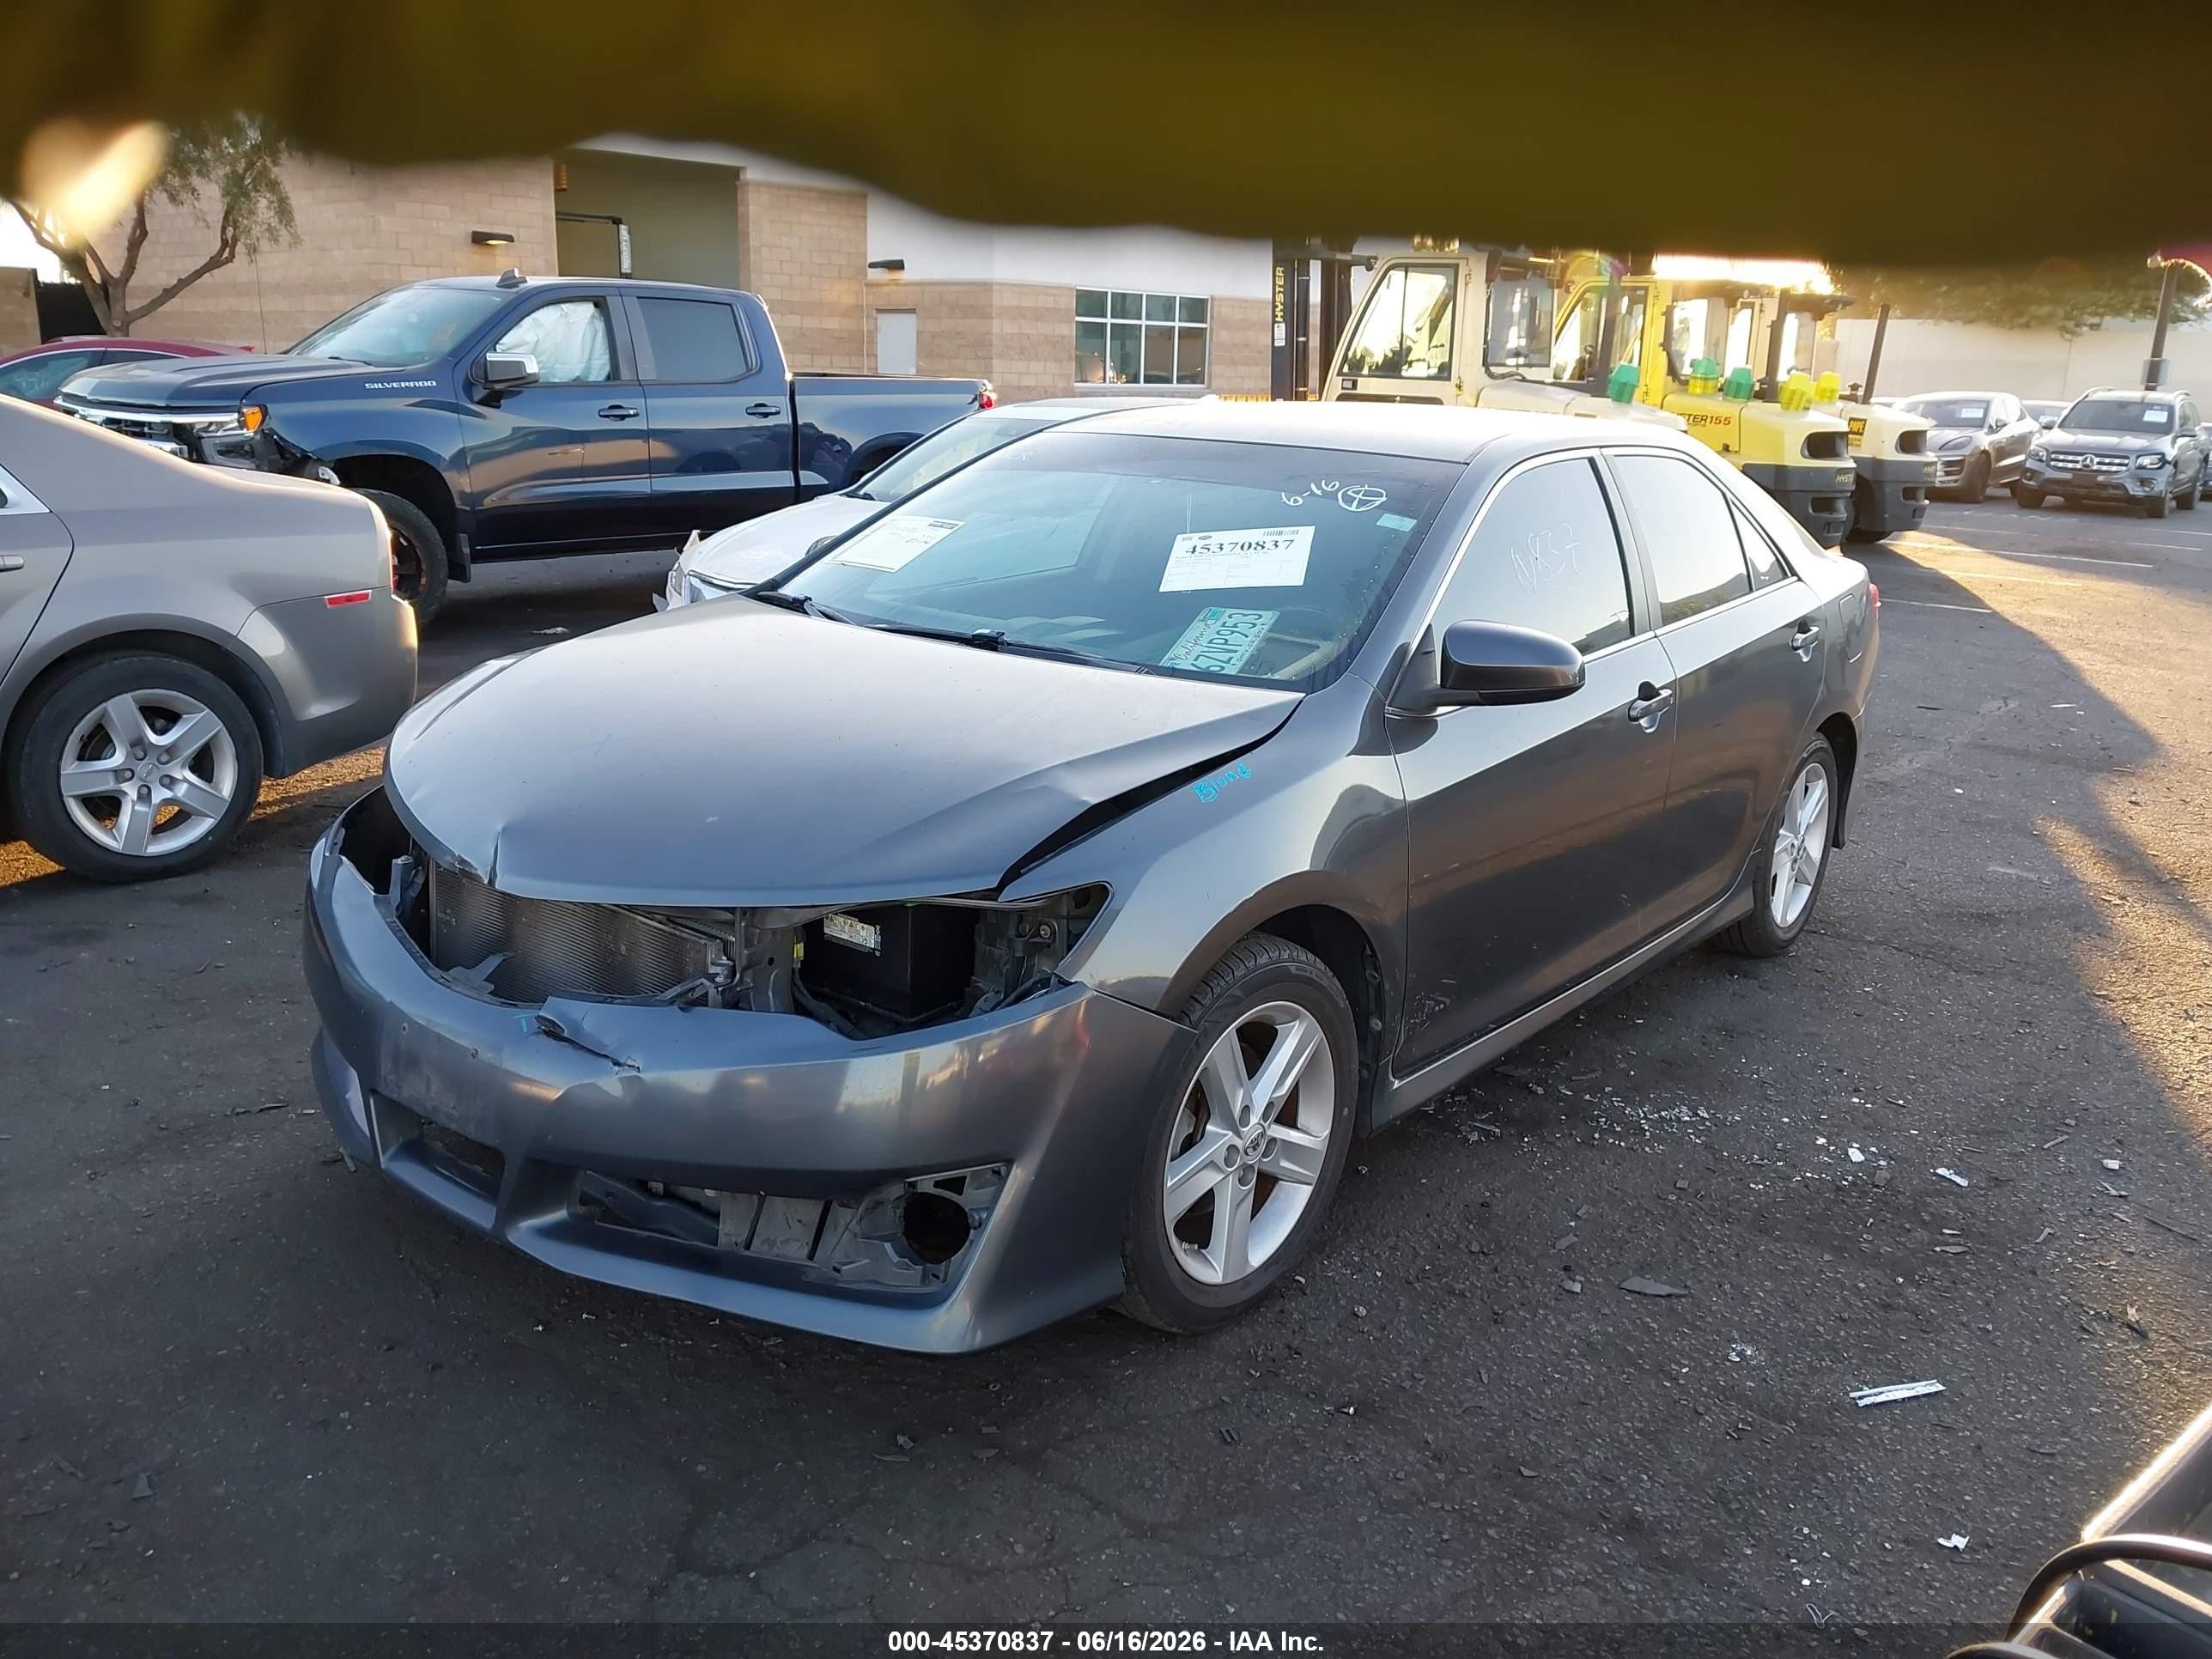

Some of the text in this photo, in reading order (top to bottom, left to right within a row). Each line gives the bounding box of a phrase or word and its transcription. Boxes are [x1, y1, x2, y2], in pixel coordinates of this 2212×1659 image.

[1274, 266, 1285, 322] HYSTER
[364, 380, 437, 389] SILVERADO
[1281, 479, 1340, 506] 6-16
[1185, 539, 1295, 555] 45370837
[1190, 612, 1264, 673] 6ZVP953
